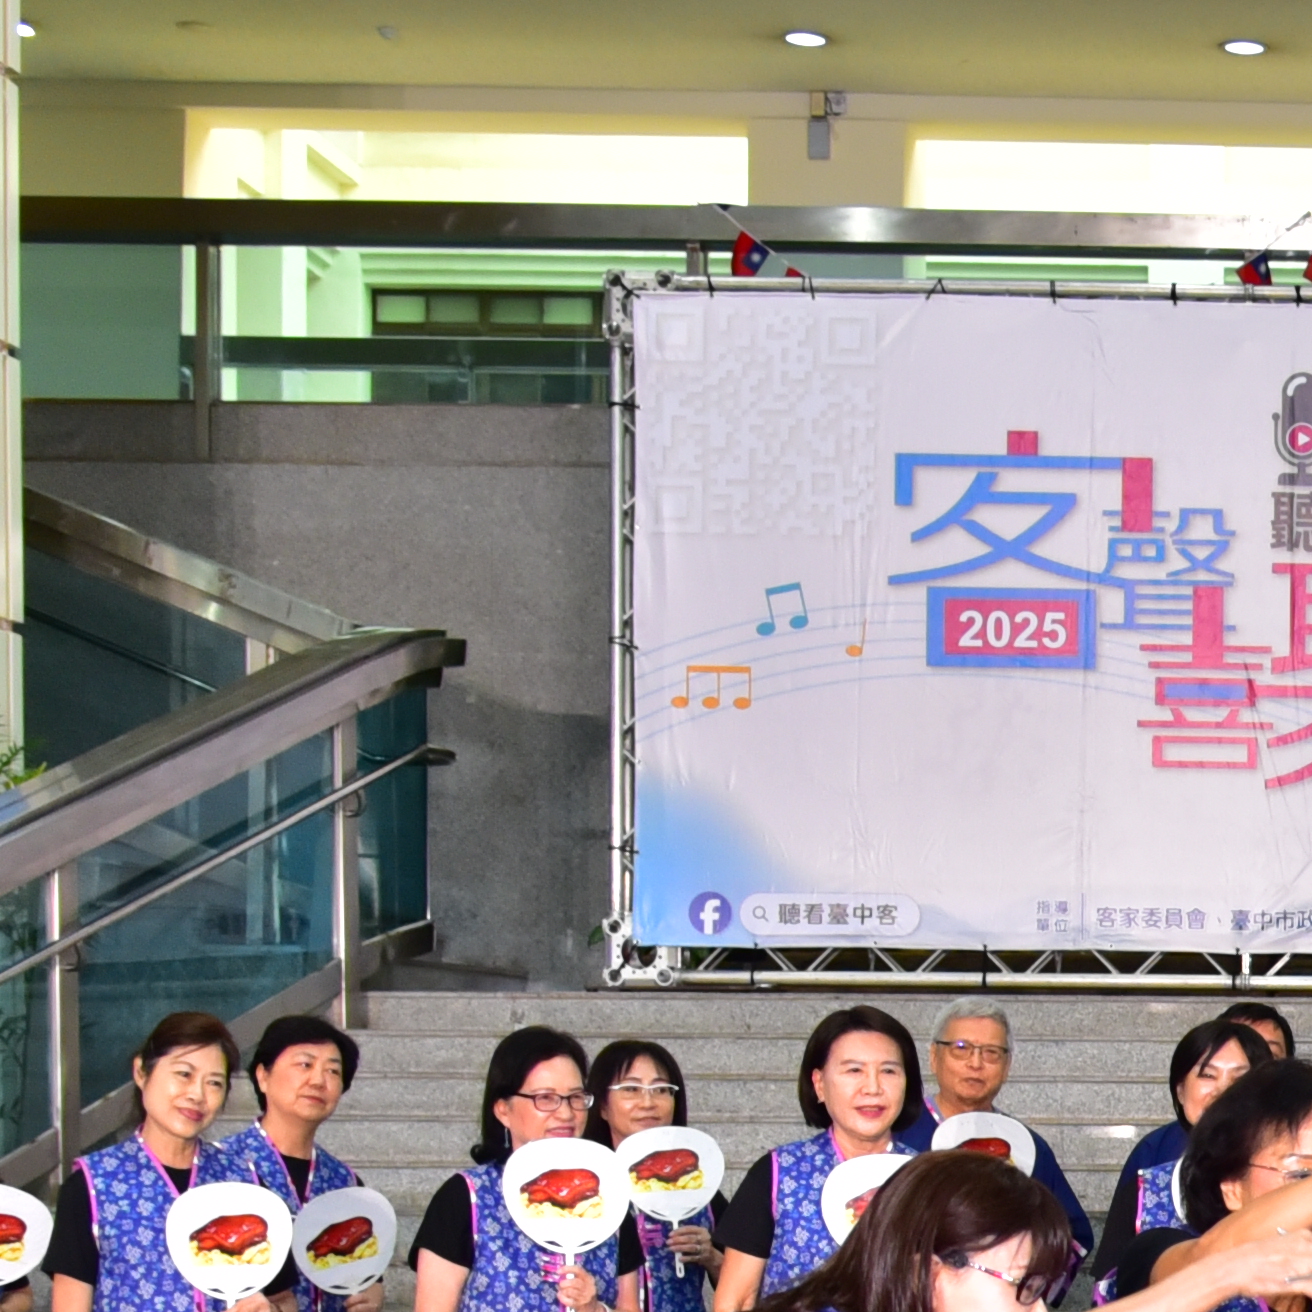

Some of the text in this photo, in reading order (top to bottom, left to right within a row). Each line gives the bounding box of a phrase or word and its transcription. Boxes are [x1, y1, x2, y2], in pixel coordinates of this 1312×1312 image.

[959, 610, 1067, 650] 2025
[778, 902, 899, 927] 聽看臺中客
